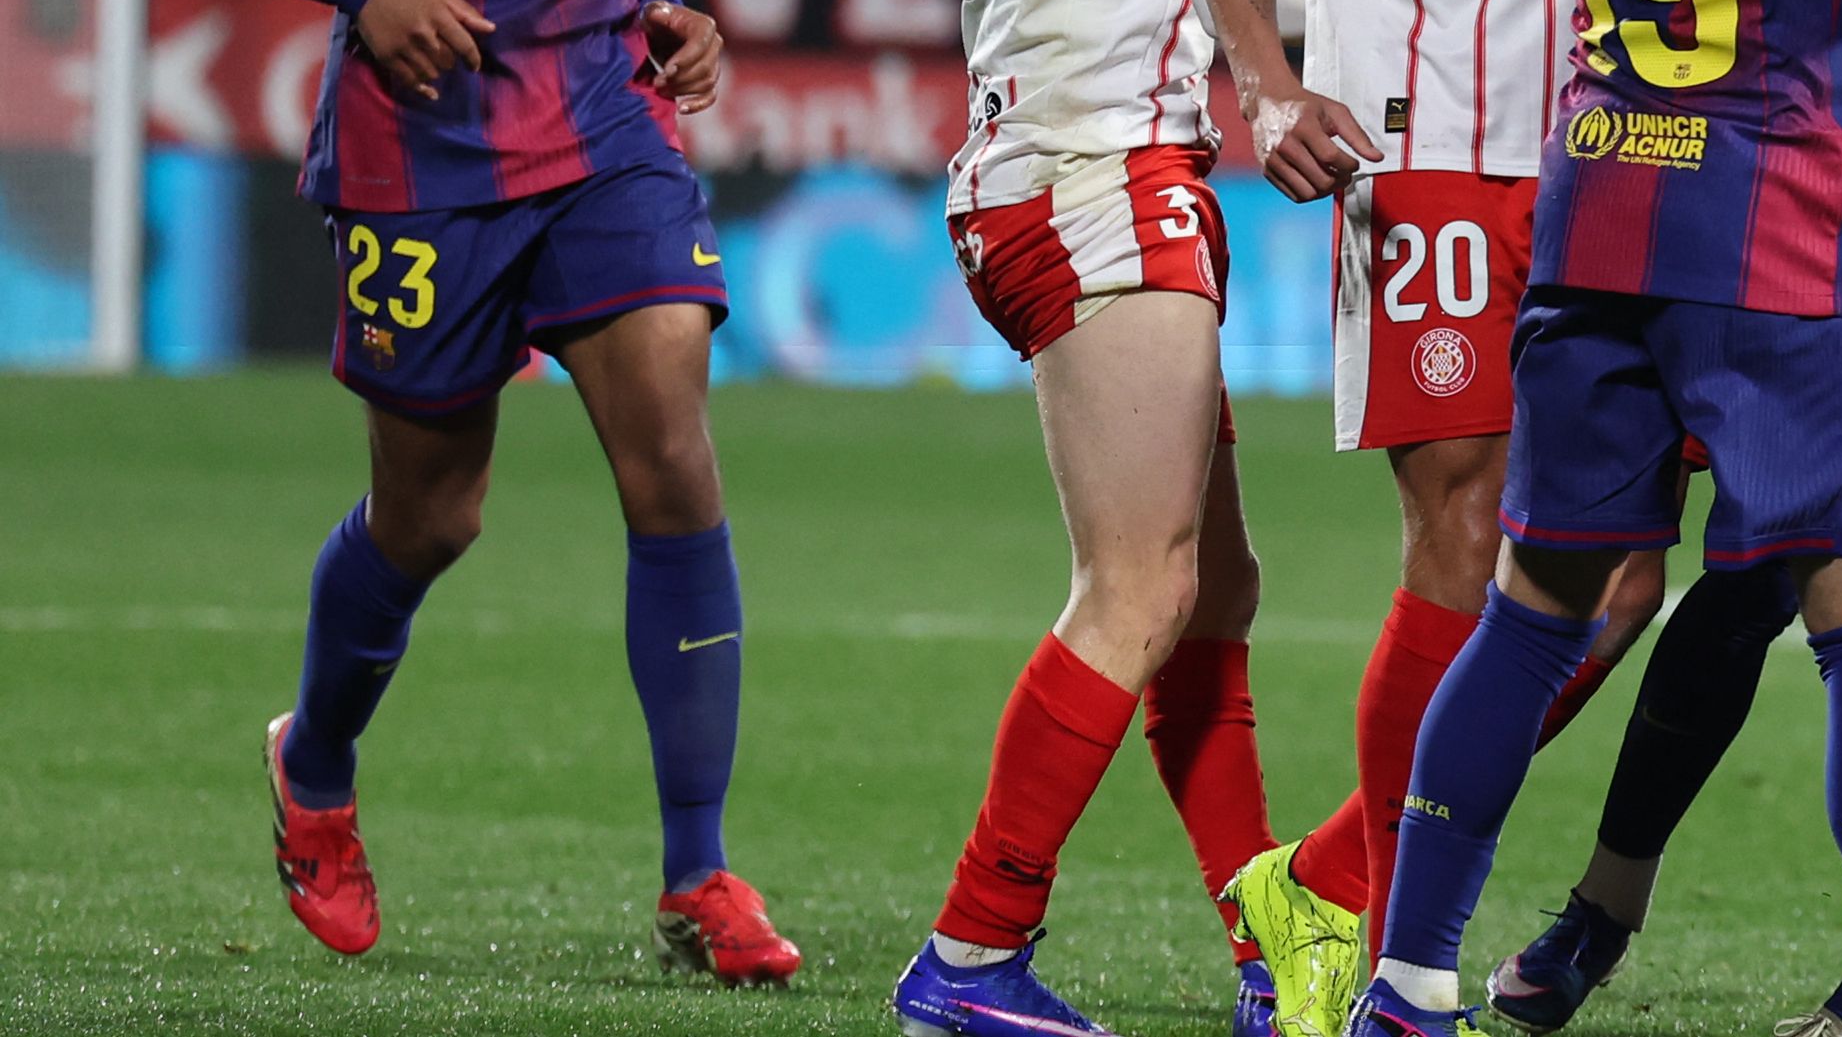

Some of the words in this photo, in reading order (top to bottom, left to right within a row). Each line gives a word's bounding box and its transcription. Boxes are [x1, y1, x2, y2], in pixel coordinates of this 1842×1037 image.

[1626, 113, 1708, 139] UNHCR
[1617, 135, 1706, 160] ACNUR
[1155, 185, 1200, 239] 3
[348, 224, 437, 328] 23
[1382, 220, 1490, 323] 20
[1420, 330, 1462, 350] GIRONA
